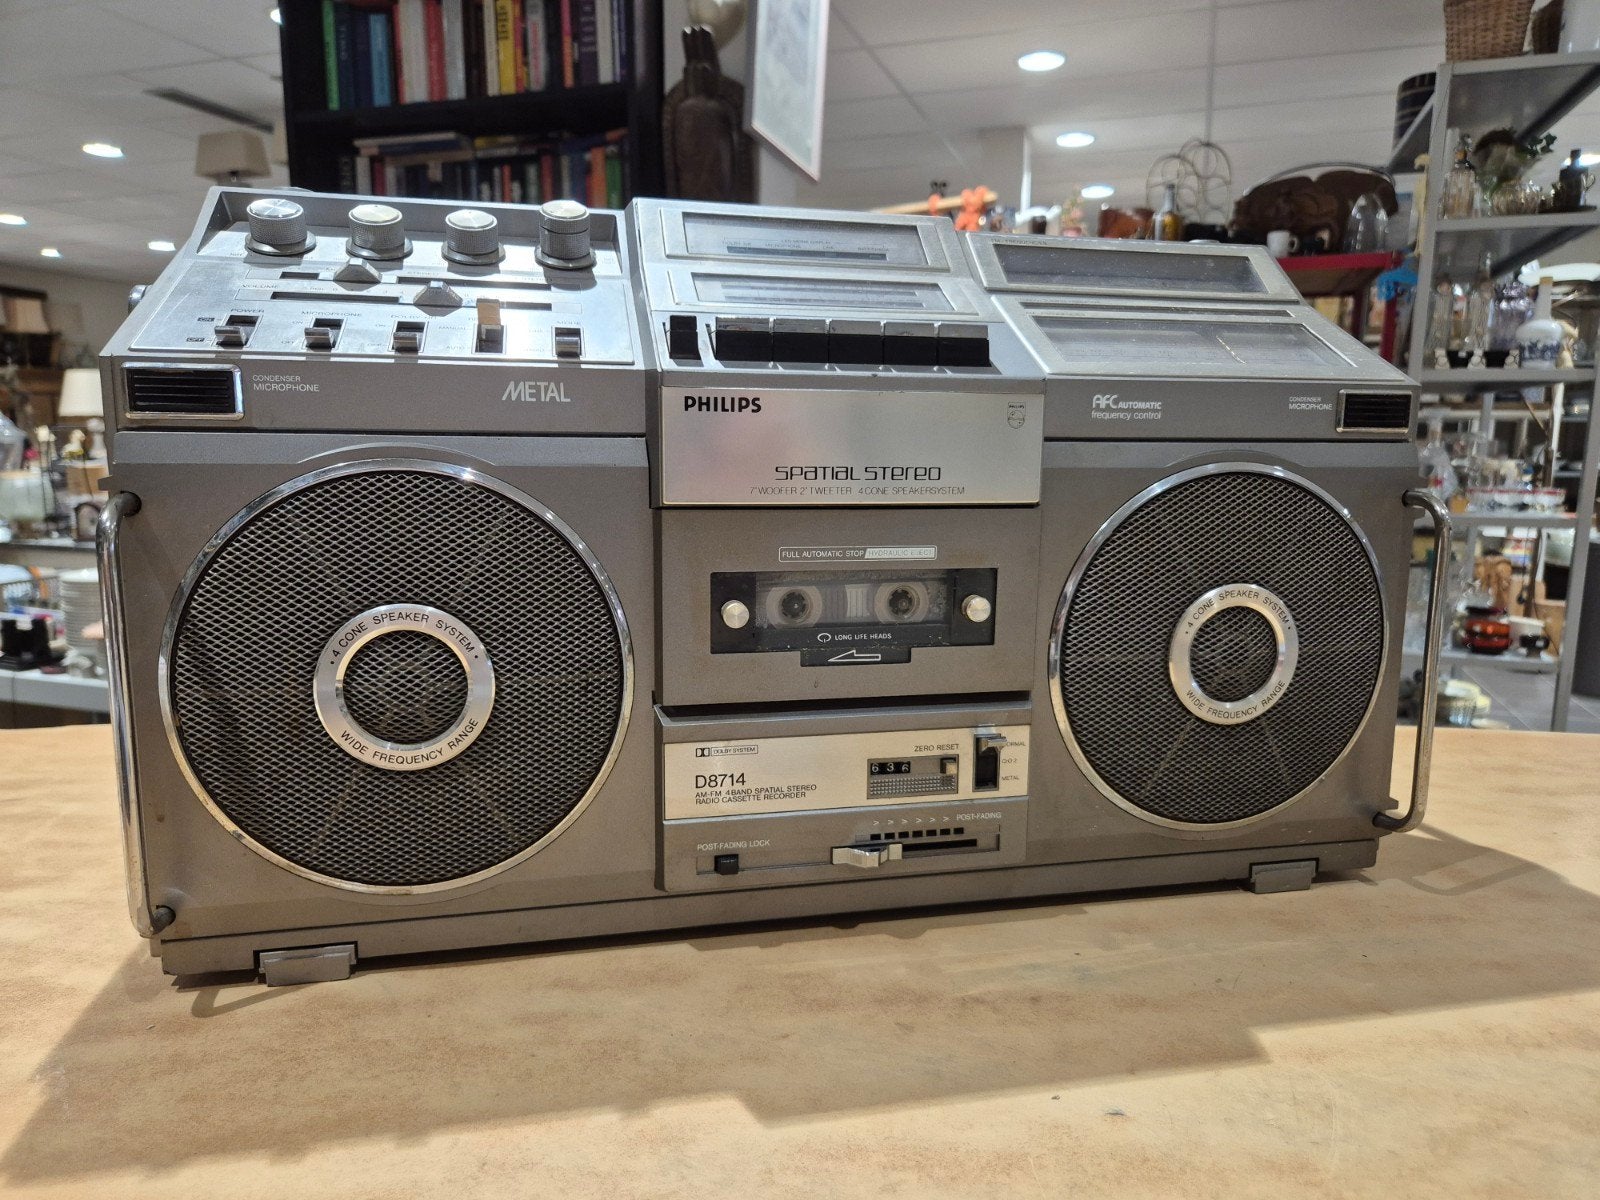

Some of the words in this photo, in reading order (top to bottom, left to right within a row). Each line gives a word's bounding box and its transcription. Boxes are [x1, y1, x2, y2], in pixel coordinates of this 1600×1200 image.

[254, 383, 320, 392] MICROPHONE
[502, 381, 571, 402] METAL
[684, 396, 762, 413] PHILIPS
[1092, 394, 1118, 409] AFC
[1092, 410, 1131, 420] frequency
[1134, 411, 1161, 420] control
[810, 487, 852, 495] TWEETER
[892, 487, 965, 495] SPEAKERSYSTEM
[1193, 599, 1215, 620] CONE
[1218, 590, 1260, 601] SPEAKER
[1262, 597, 1290, 624] SYSTEM
[333, 650, 341, 658] 4
[338, 622, 369, 648] CONE
[373, 612, 430, 625] SPEAKER
[435, 620, 476, 655] SYSTEM
[1186, 689, 1204, 711] WIDE
[1206, 706, 1258, 719] FREQUENCY
[1262, 680, 1286, 707] RANGE
[341, 730, 369, 755] WIDE
[373, 748, 445, 766] FREQUENCY
[448, 718, 479, 750] RANGE
[695, 773, 747, 789] D8714
[695, 791, 722, 799] AM-FM
[754, 787, 785, 795] SPATIAL
[787, 784, 817, 792] STEREO
[696, 797, 720, 805] RADIO
[722, 794, 761, 803] CASSETTE
[764, 792, 806, 800] RECORDER
[956, 812, 1002, 821] POST-FADING
[697, 841, 747, 851] POST-FADING
[749, 840, 770, 848] LOCK
